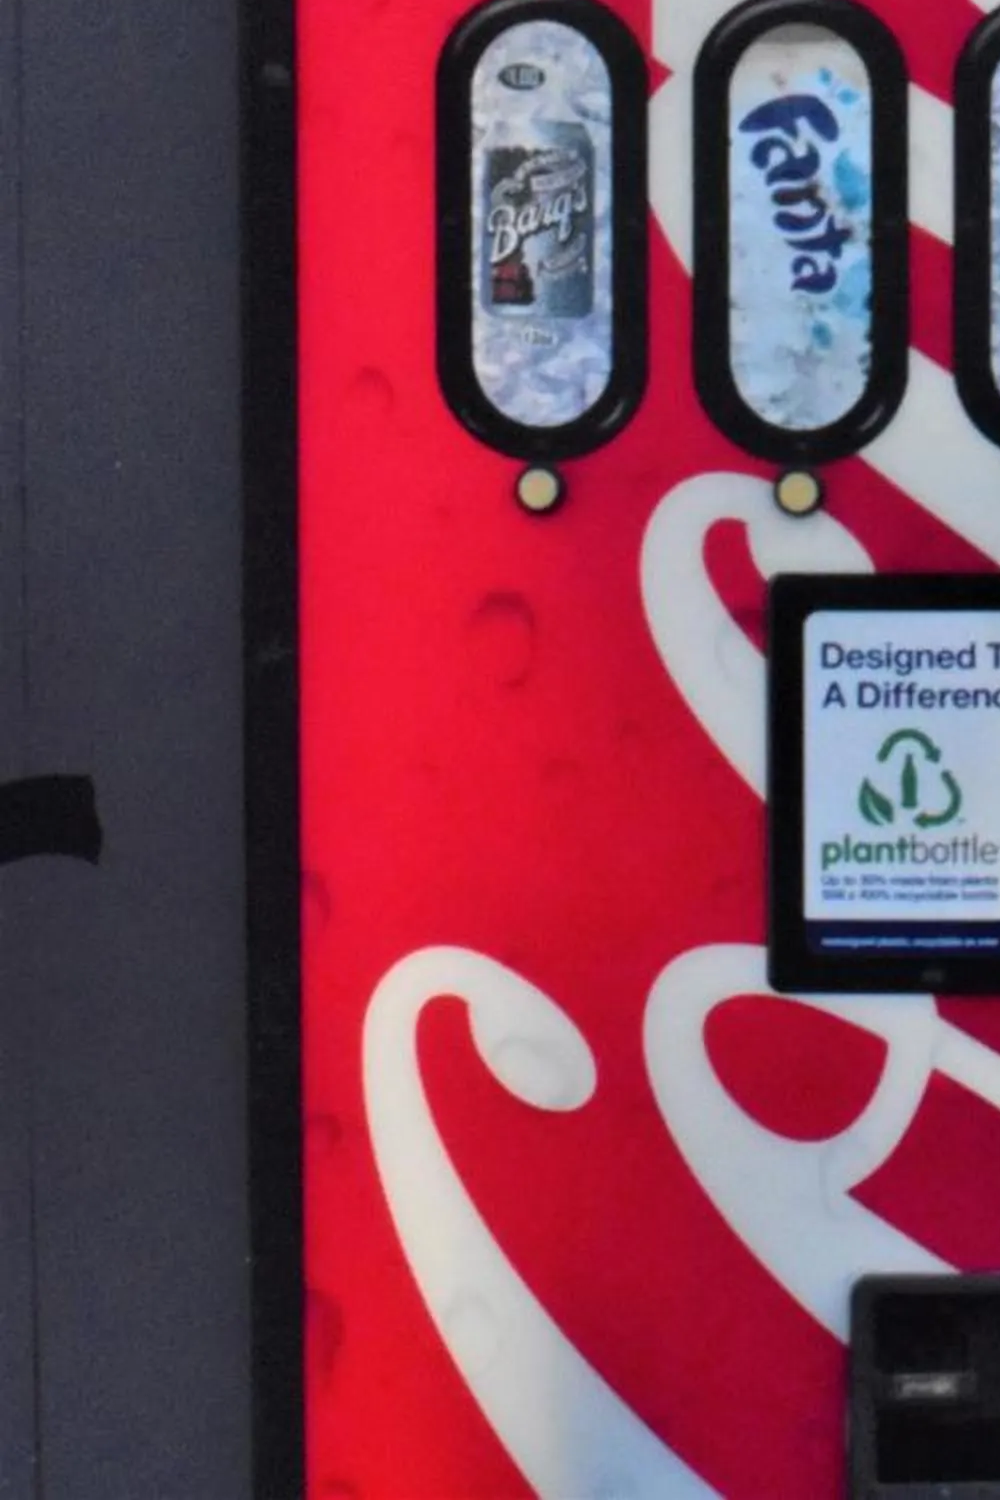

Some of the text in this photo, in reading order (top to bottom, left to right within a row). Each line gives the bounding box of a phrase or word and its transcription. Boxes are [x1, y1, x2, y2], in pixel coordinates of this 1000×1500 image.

[738, 94, 854, 296] Fanta
[820, 641, 976, 676] Designed
[822, 681, 847, 709] A
[821, 833, 999, 871] plantbottle
